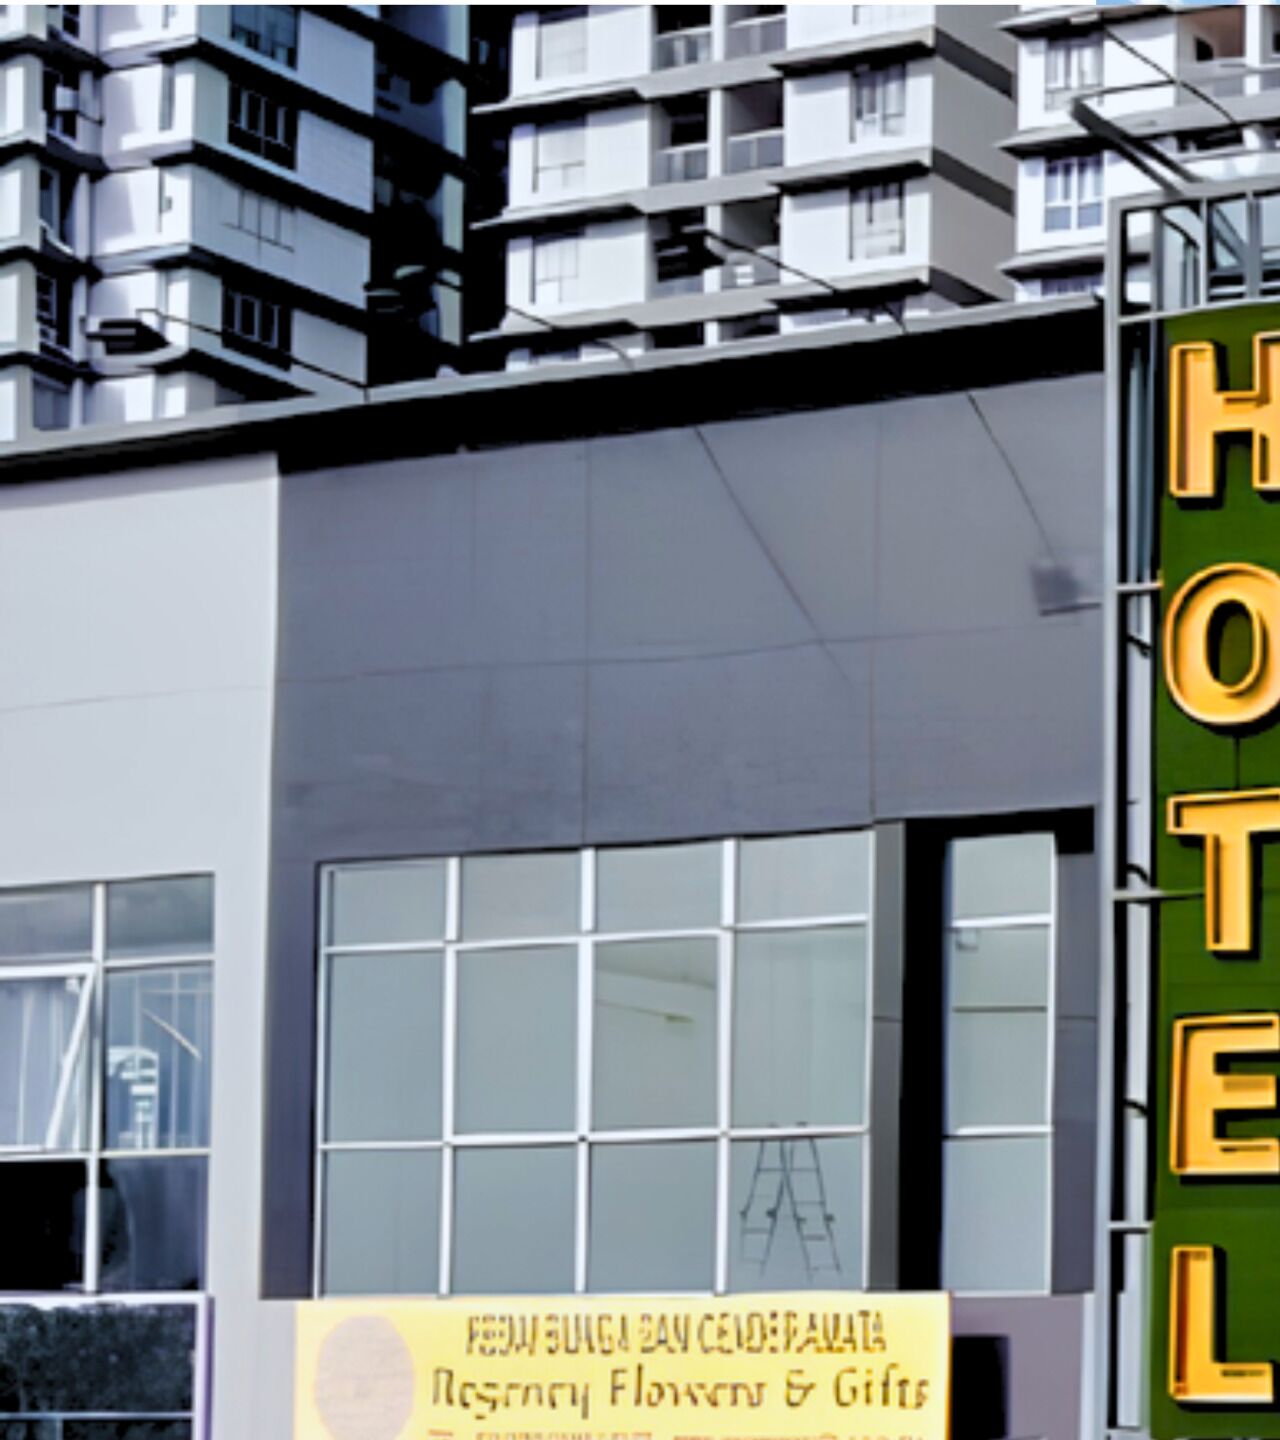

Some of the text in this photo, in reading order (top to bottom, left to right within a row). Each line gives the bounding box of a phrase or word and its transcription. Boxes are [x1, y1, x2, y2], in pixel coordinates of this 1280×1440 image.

[610, 1363, 766, 1408] Flowers
[786, 1369, 816, 1407] &
[834, 1362, 930, 1409] Gifts
